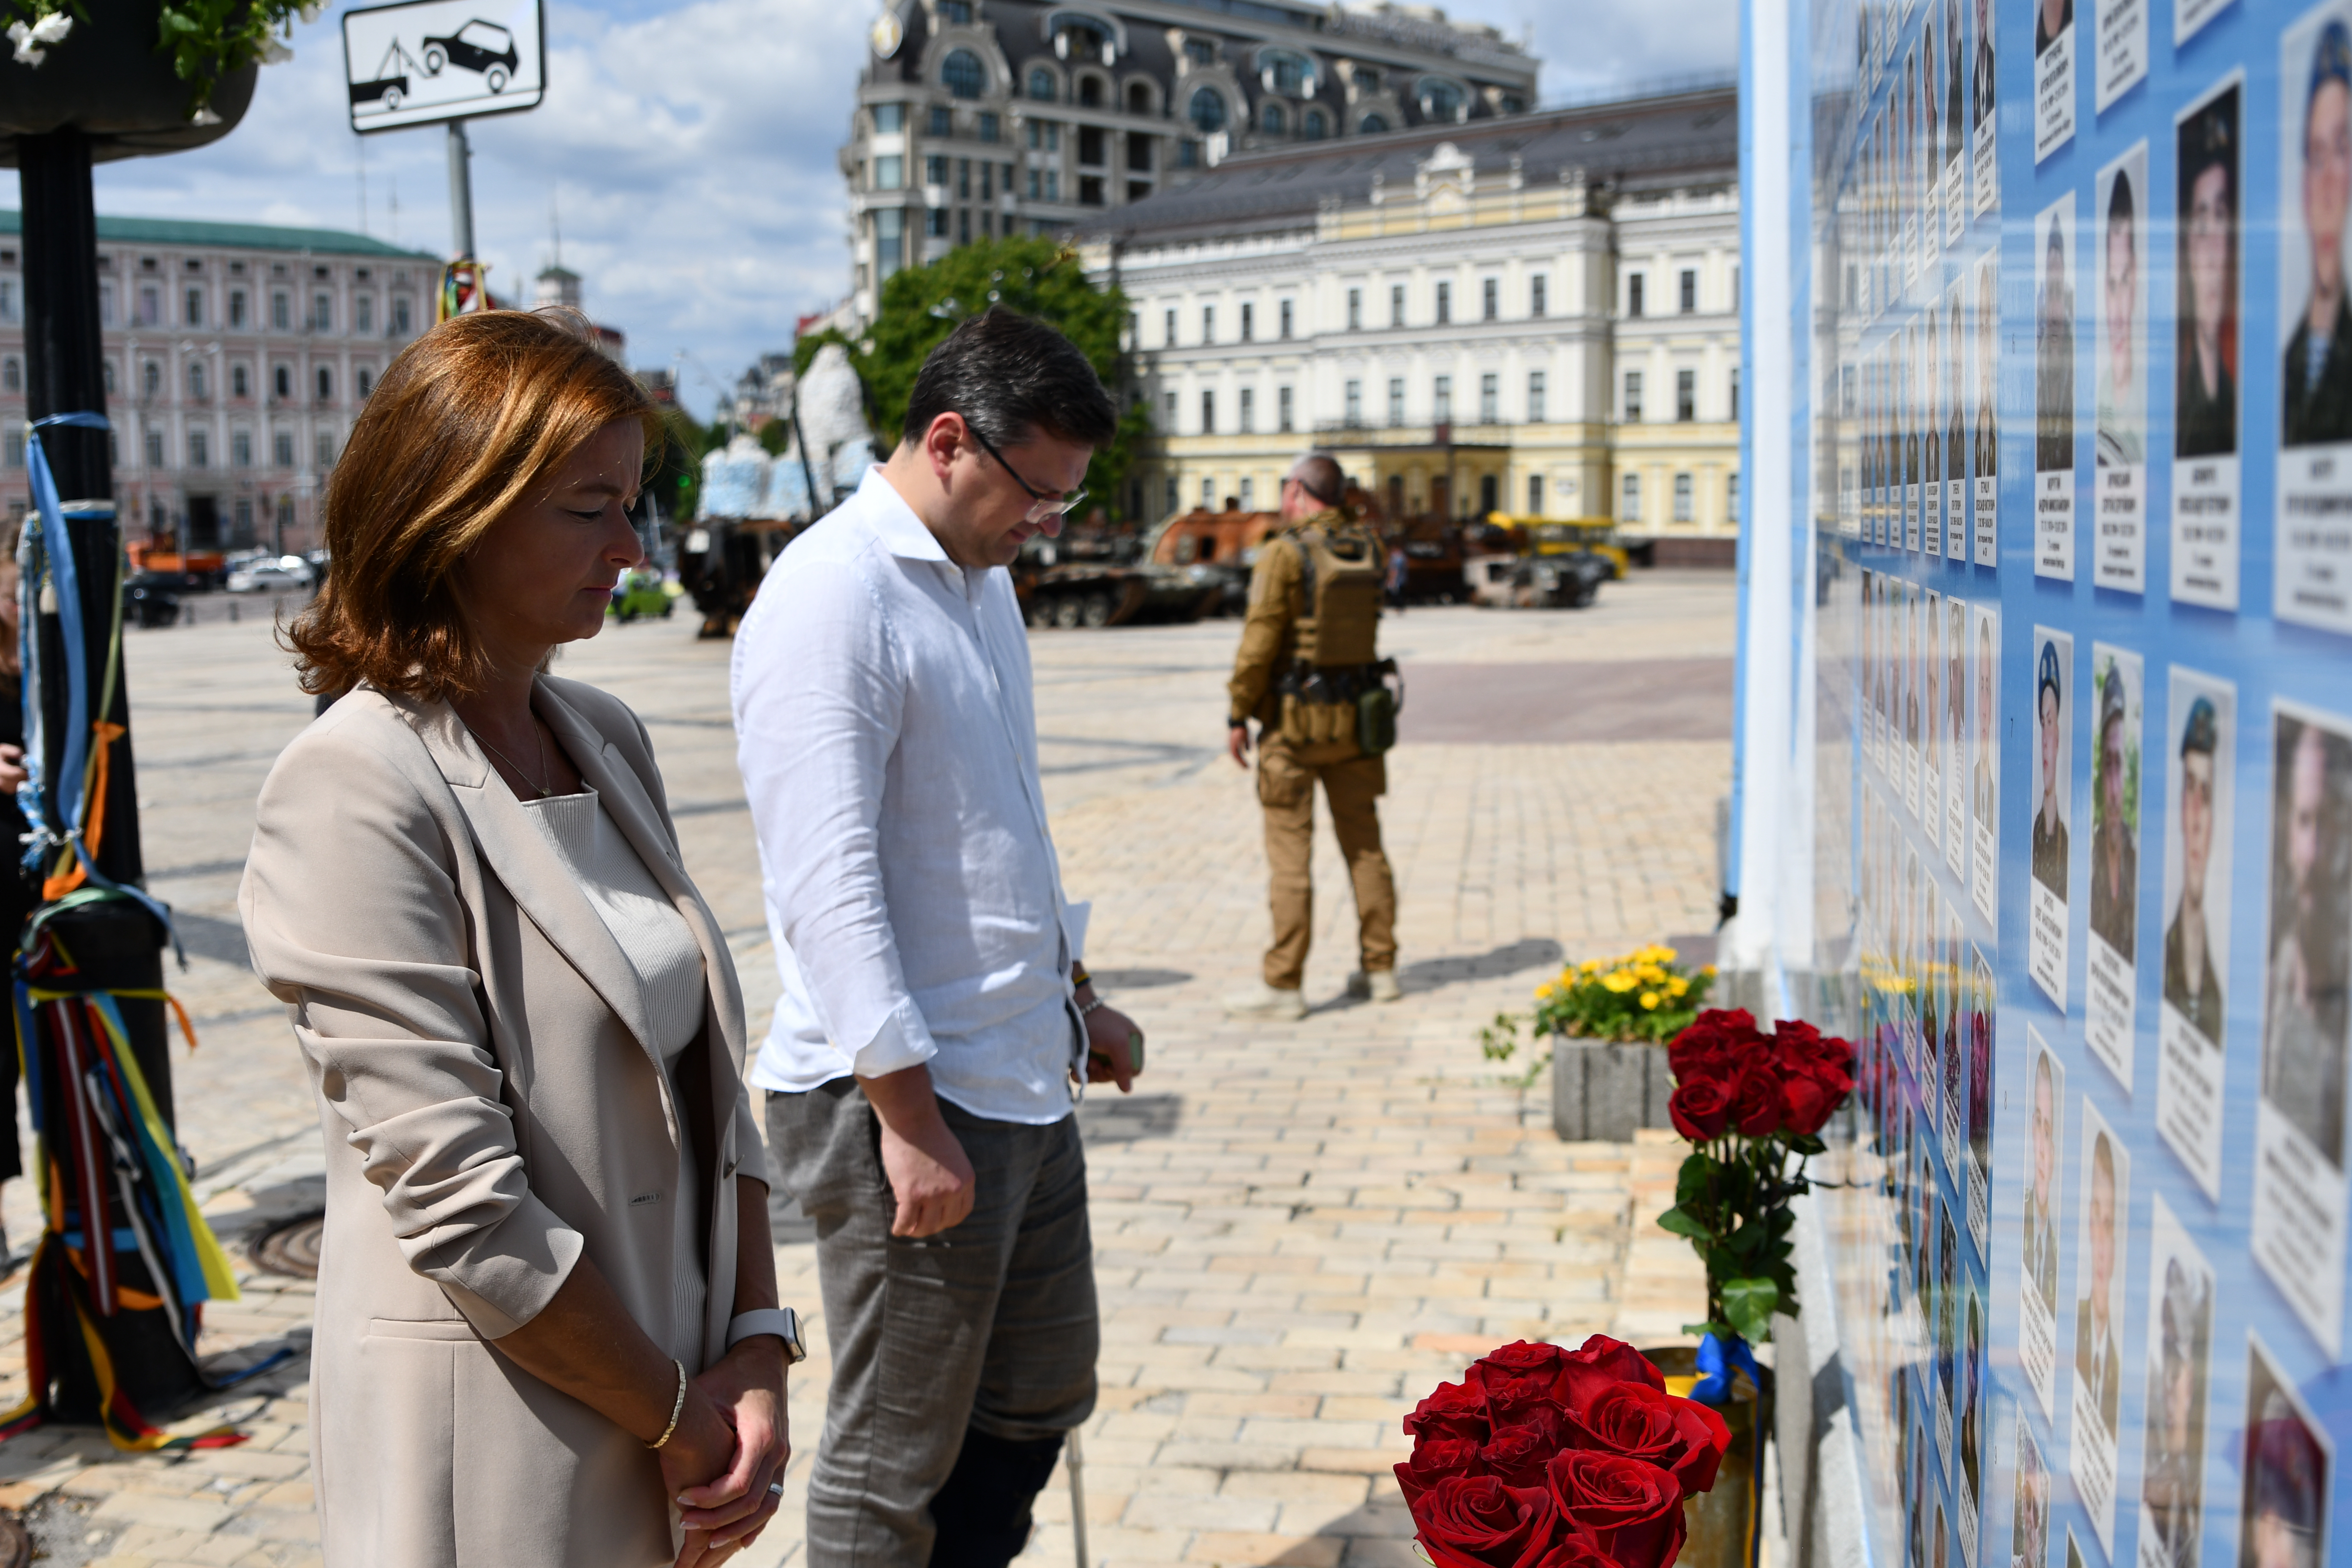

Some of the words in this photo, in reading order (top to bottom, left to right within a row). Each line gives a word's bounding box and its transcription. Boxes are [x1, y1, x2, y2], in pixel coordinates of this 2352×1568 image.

[2012, 332, 2015, 354] 6
[2010, 717, 2013, 738] 7
[2004, 1090, 2007, 1110] 8
[1995, 1445, 1997, 1465] 9
